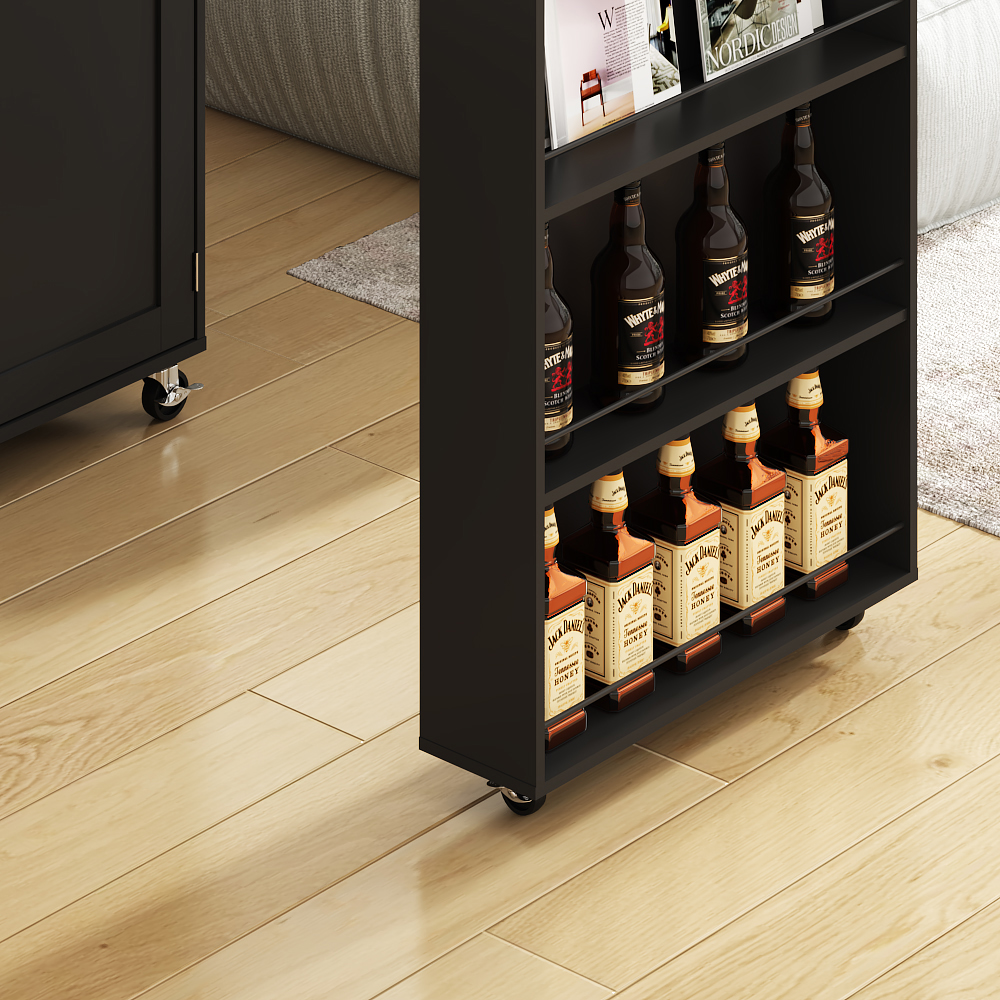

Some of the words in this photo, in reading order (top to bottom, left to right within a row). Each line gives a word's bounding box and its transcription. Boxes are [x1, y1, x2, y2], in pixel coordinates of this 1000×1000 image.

[808, 267, 827, 275] SCOTCH
[720, 310, 740, 318] SCOTCH
[636, 352, 656, 360] SCOTCH
[814, 482, 829, 505] JACK
[751, 517, 765, 540] JACK
[820, 520, 843, 538] HONEY
[685, 553, 700, 576] JACK
[756, 556, 780, 574] HONEY
[617, 590, 632, 613] JACK
[691, 592, 715, 610] HONEY
[548, 626, 564, 651] JACK
[623, 629, 648, 648] HONEY
[554, 667, 579, 686] HONEY
